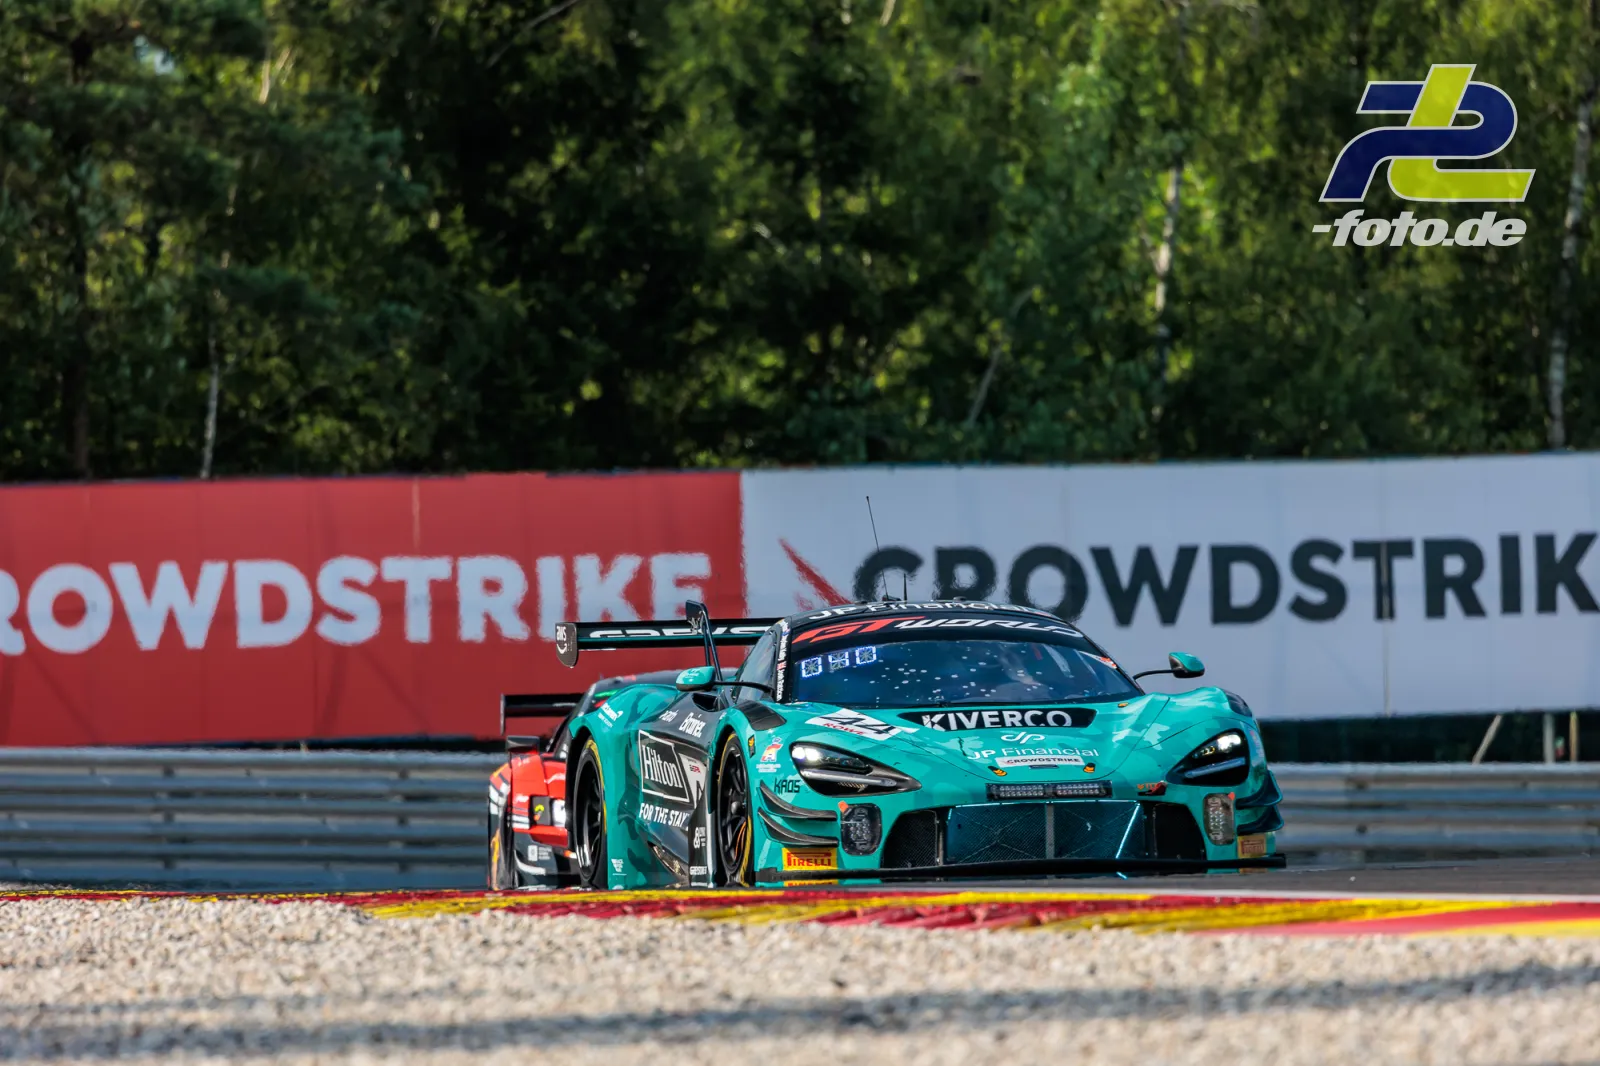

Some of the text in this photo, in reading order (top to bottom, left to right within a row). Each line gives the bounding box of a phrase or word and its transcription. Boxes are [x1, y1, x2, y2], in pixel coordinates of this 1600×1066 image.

[819, 716, 897, 735] 44
[823, 723, 866, 735] ROWE
[921, 710, 1073, 732] KIVERCO
[967, 747, 1099, 760] JP Financial
[641, 744, 683, 789] Hilton
[774, 778, 801, 795] KAOS
[639, 803, 654, 820] FOR
[655, 806, 669, 825] THE
[786, 852, 832, 867] PIRELLI
